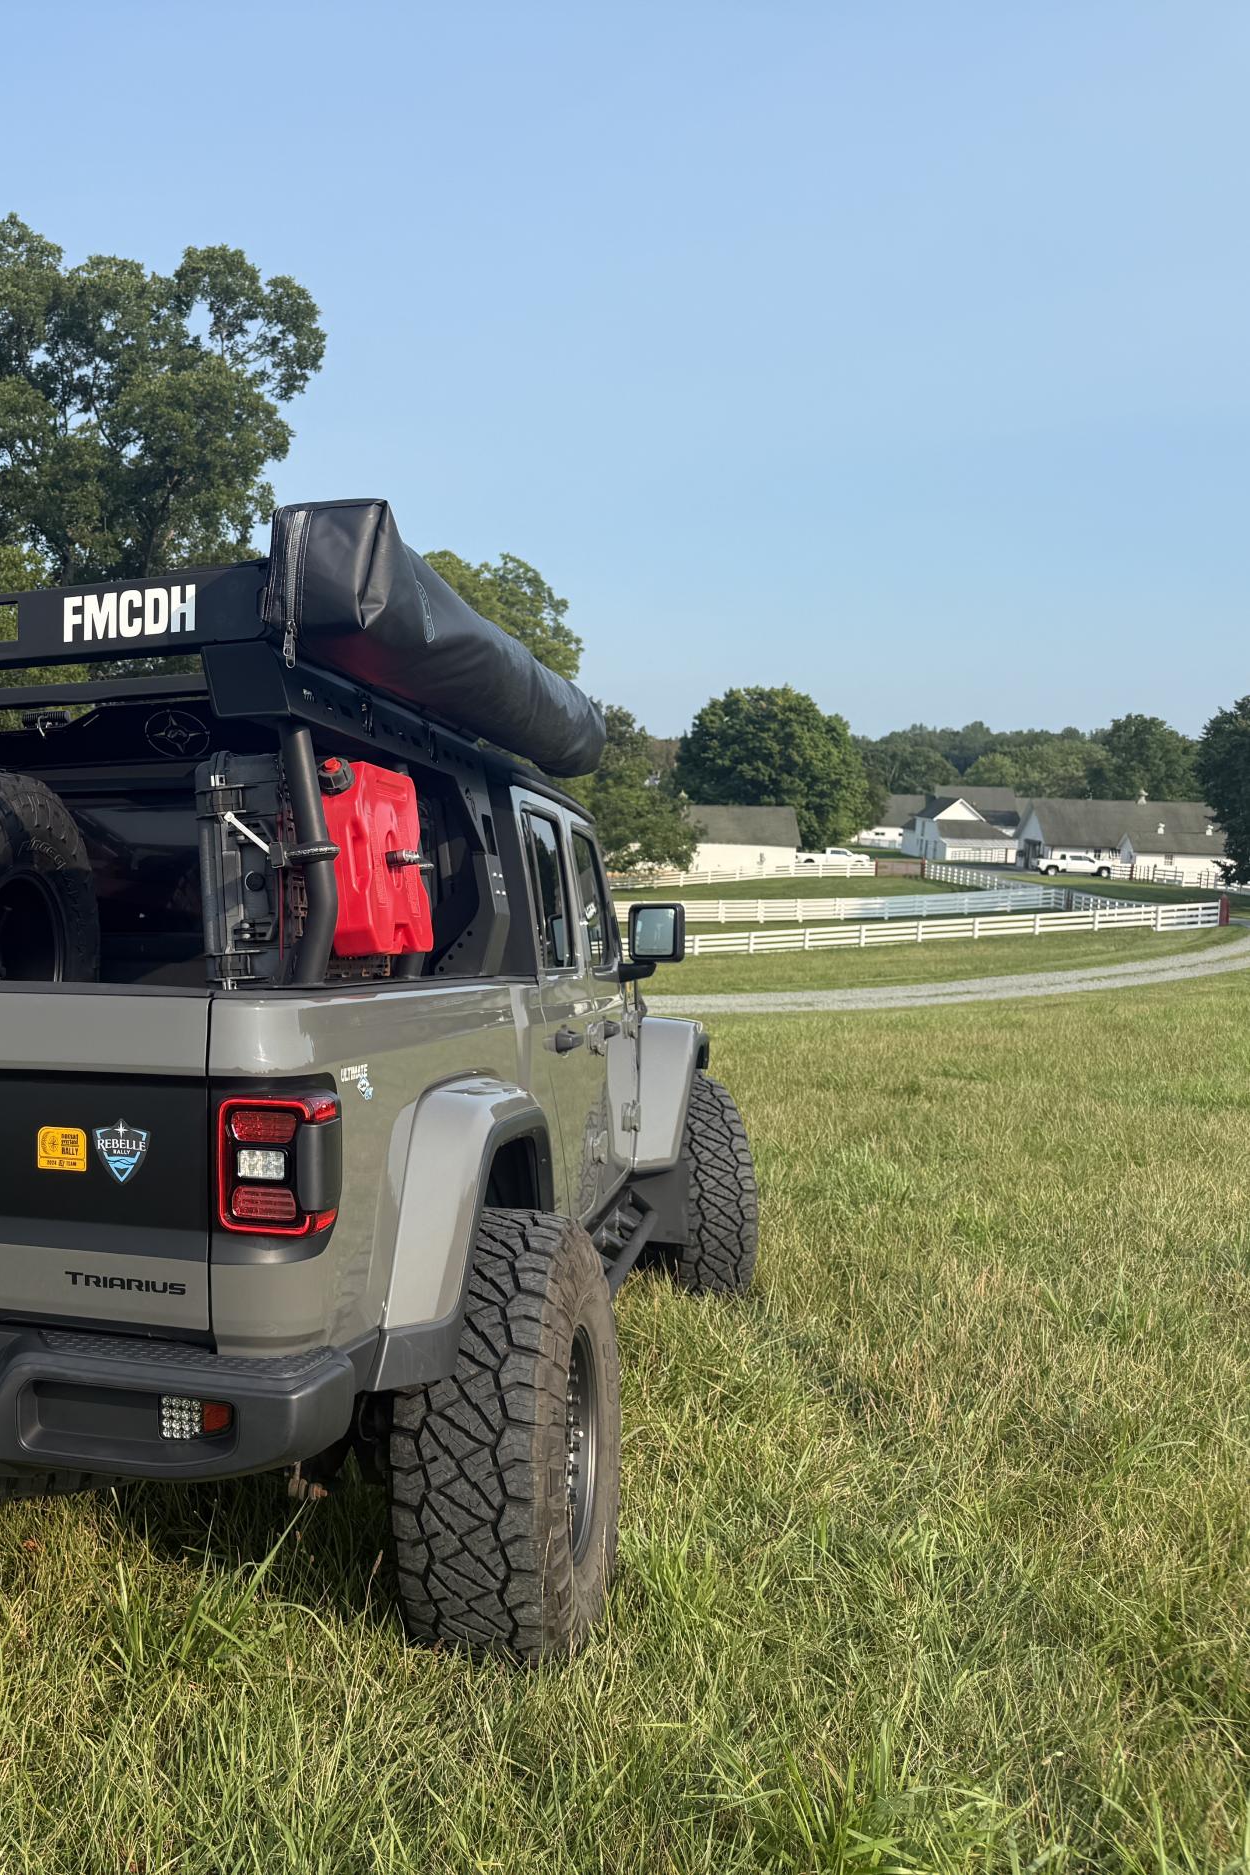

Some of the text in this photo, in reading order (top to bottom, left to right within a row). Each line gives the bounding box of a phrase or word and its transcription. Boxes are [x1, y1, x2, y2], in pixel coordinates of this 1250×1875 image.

[63, 584, 196, 643] FMCDH
[97, 1138, 147, 1152] REBELLE
[64, 1270, 187, 1296] TRIARIUS
